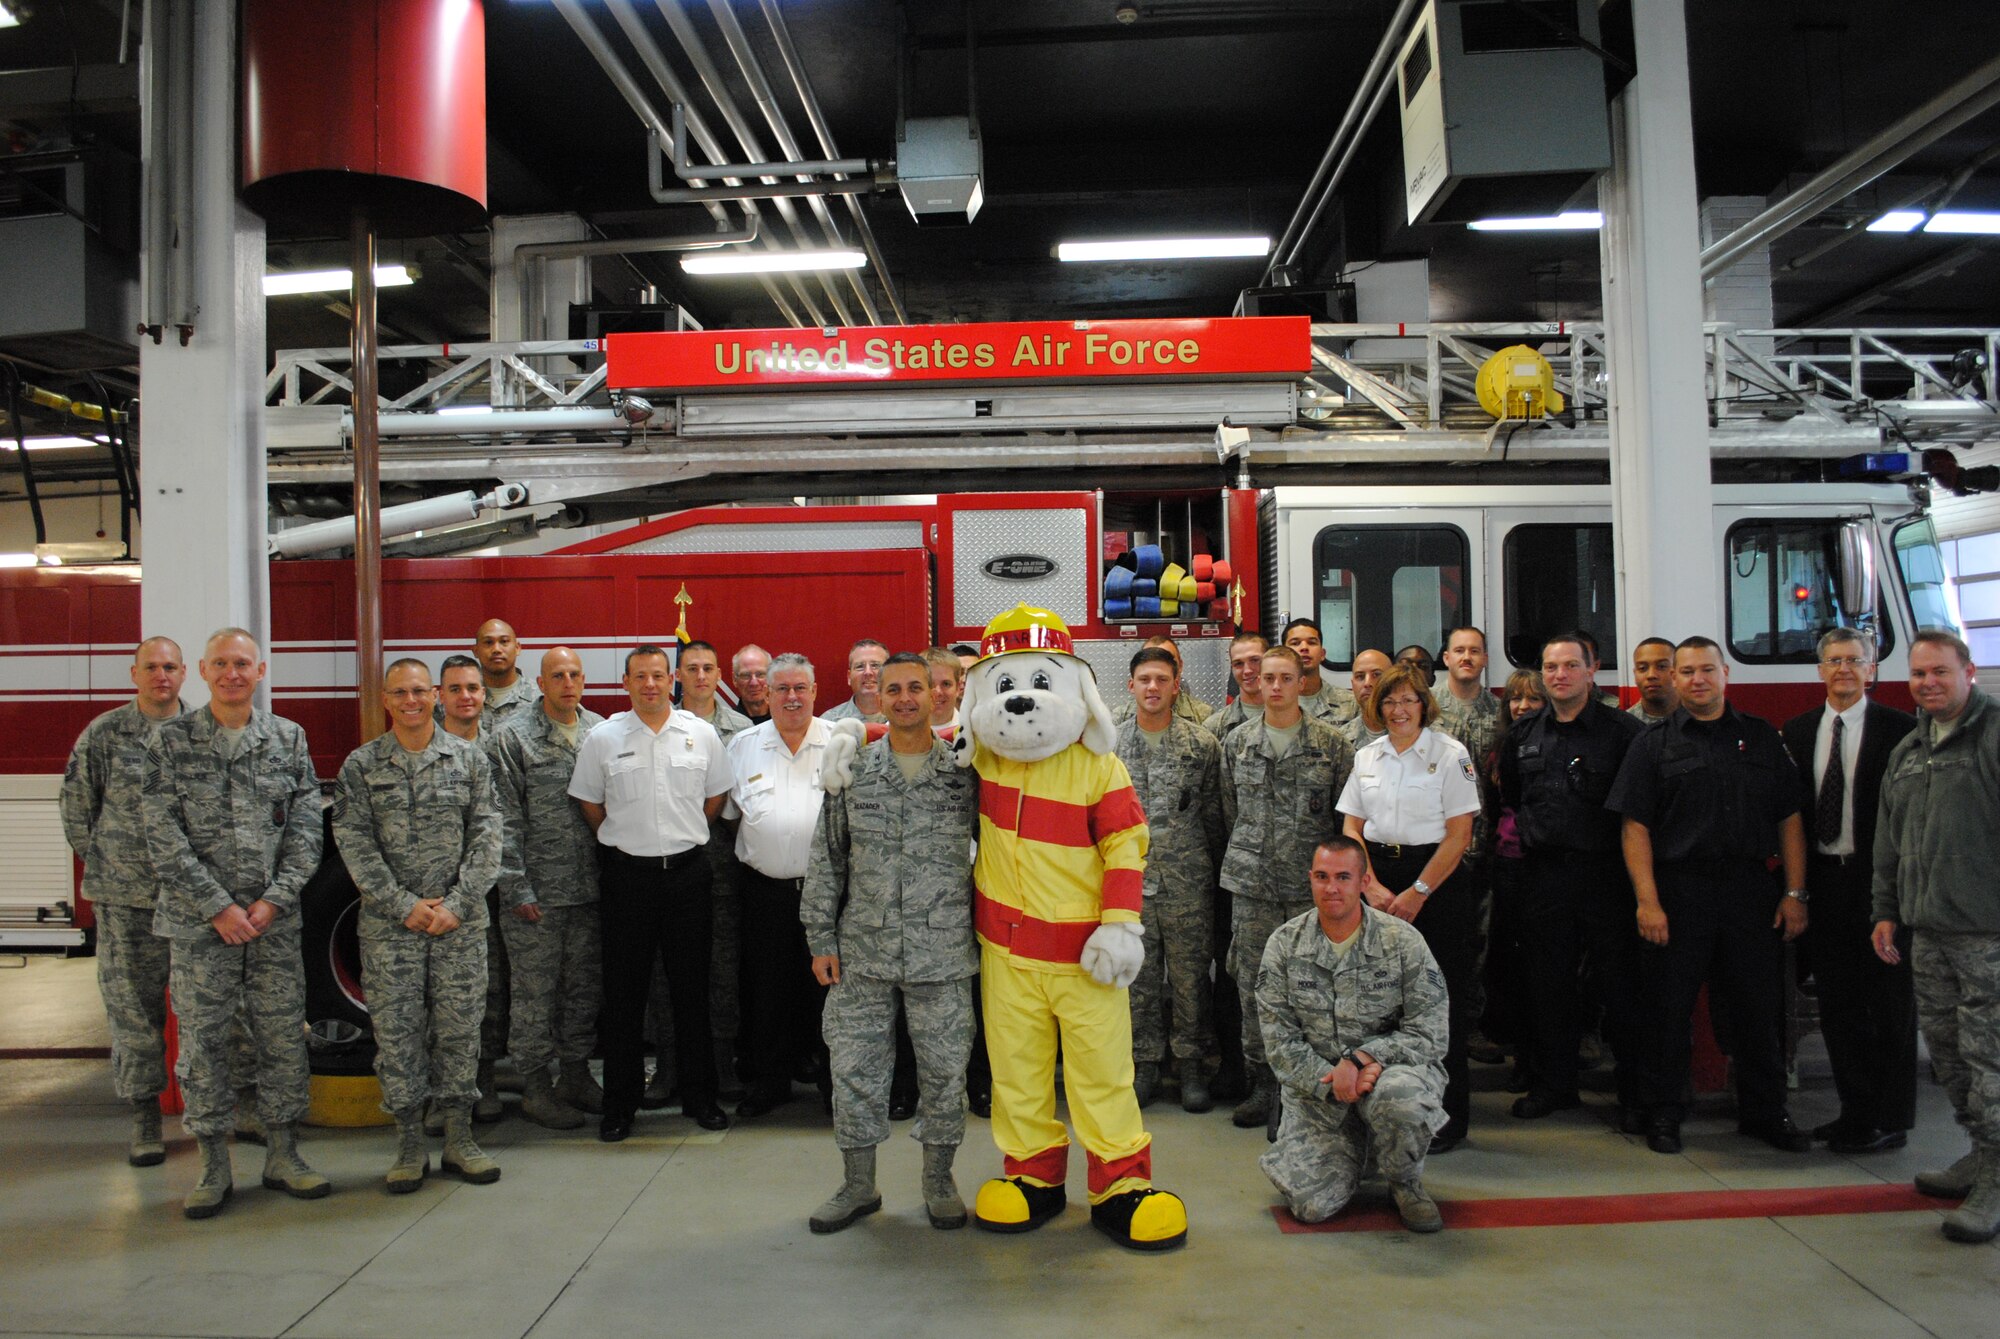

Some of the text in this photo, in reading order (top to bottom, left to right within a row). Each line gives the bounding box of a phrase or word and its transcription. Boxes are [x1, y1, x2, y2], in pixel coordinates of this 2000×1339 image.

[1546, 324, 1558, 332] 75
[584, 341, 597, 349] 45
[715, 334, 1199, 374] United States Air Force
[991, 561, 1048, 574] E-ONE
[993, 629, 1054, 648] SPAR
